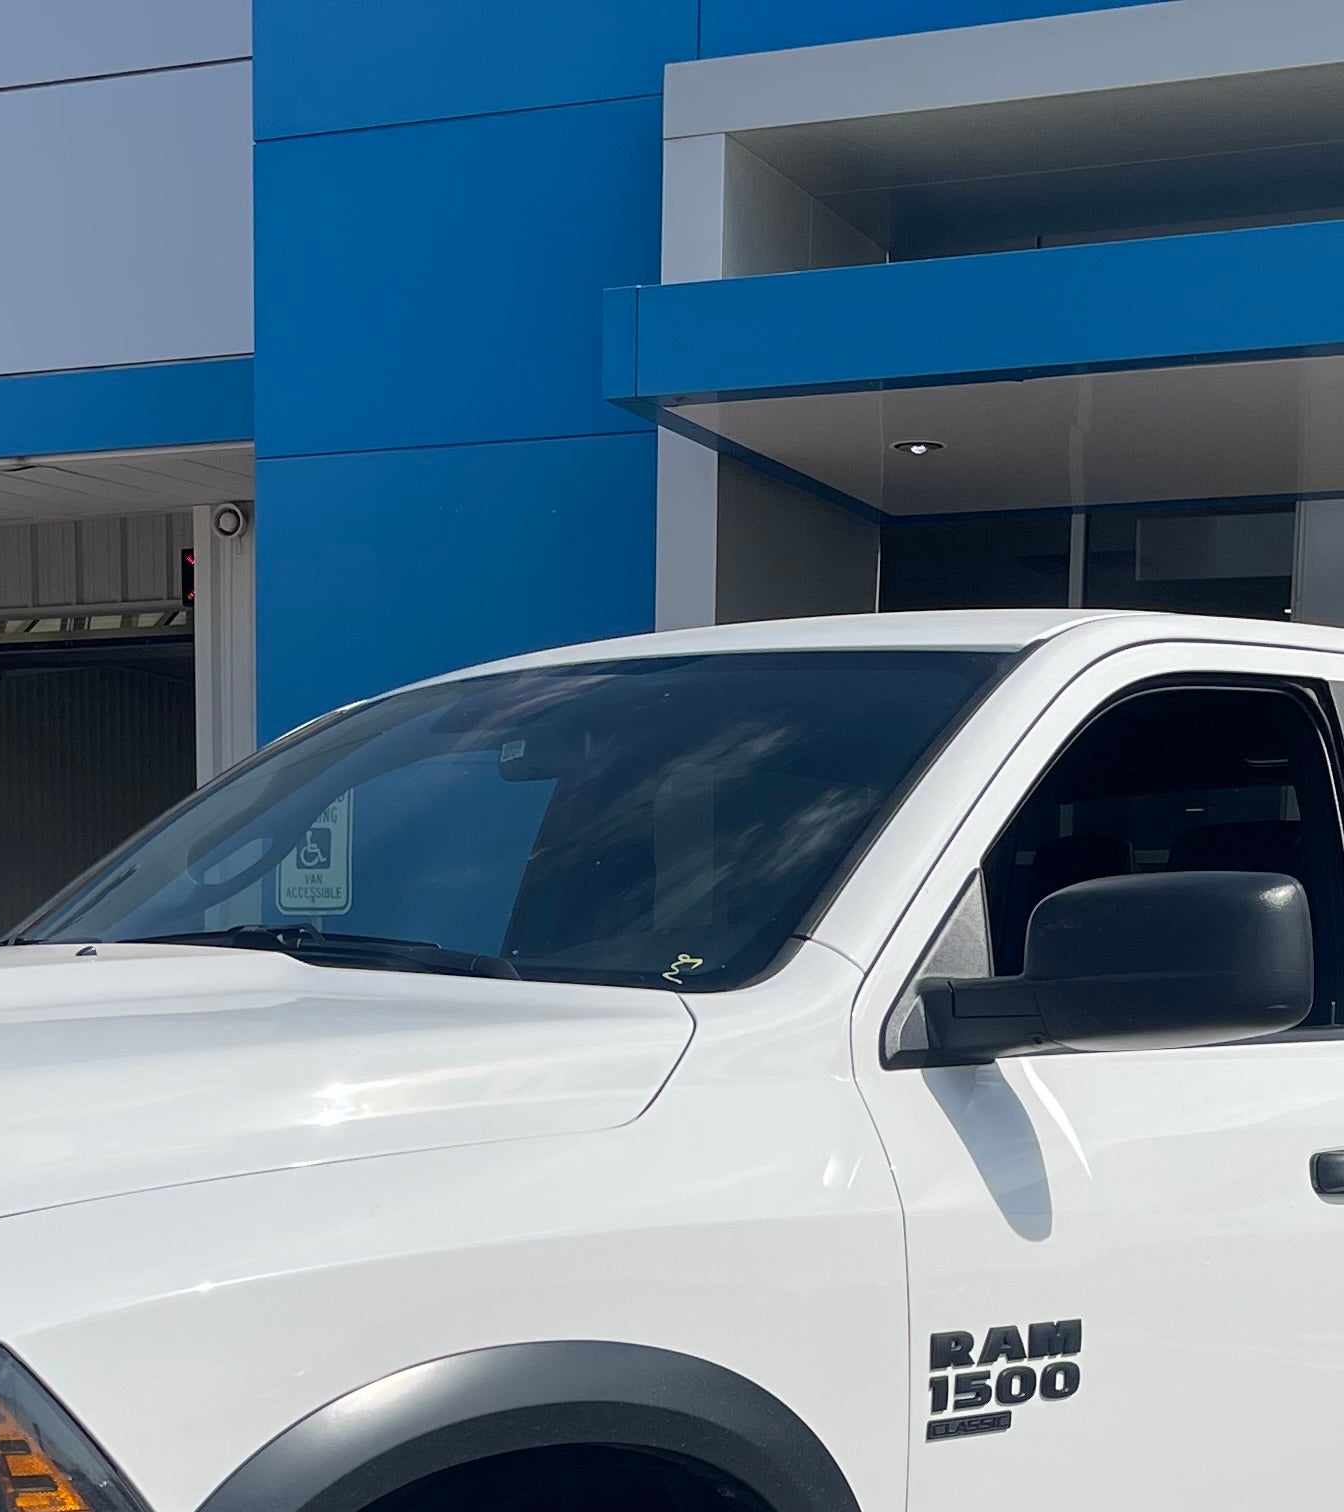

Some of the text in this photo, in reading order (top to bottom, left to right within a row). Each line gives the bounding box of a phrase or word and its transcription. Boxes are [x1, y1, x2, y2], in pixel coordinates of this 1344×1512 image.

[305, 873, 323, 885] VAN
[286, 886, 342, 899] ACCESSIBLE
[929, 1318, 1083, 1372] RAM
[928, 1361, 1081, 1415] 1500
[931, 1415, 1011, 1438] CLASSIC
